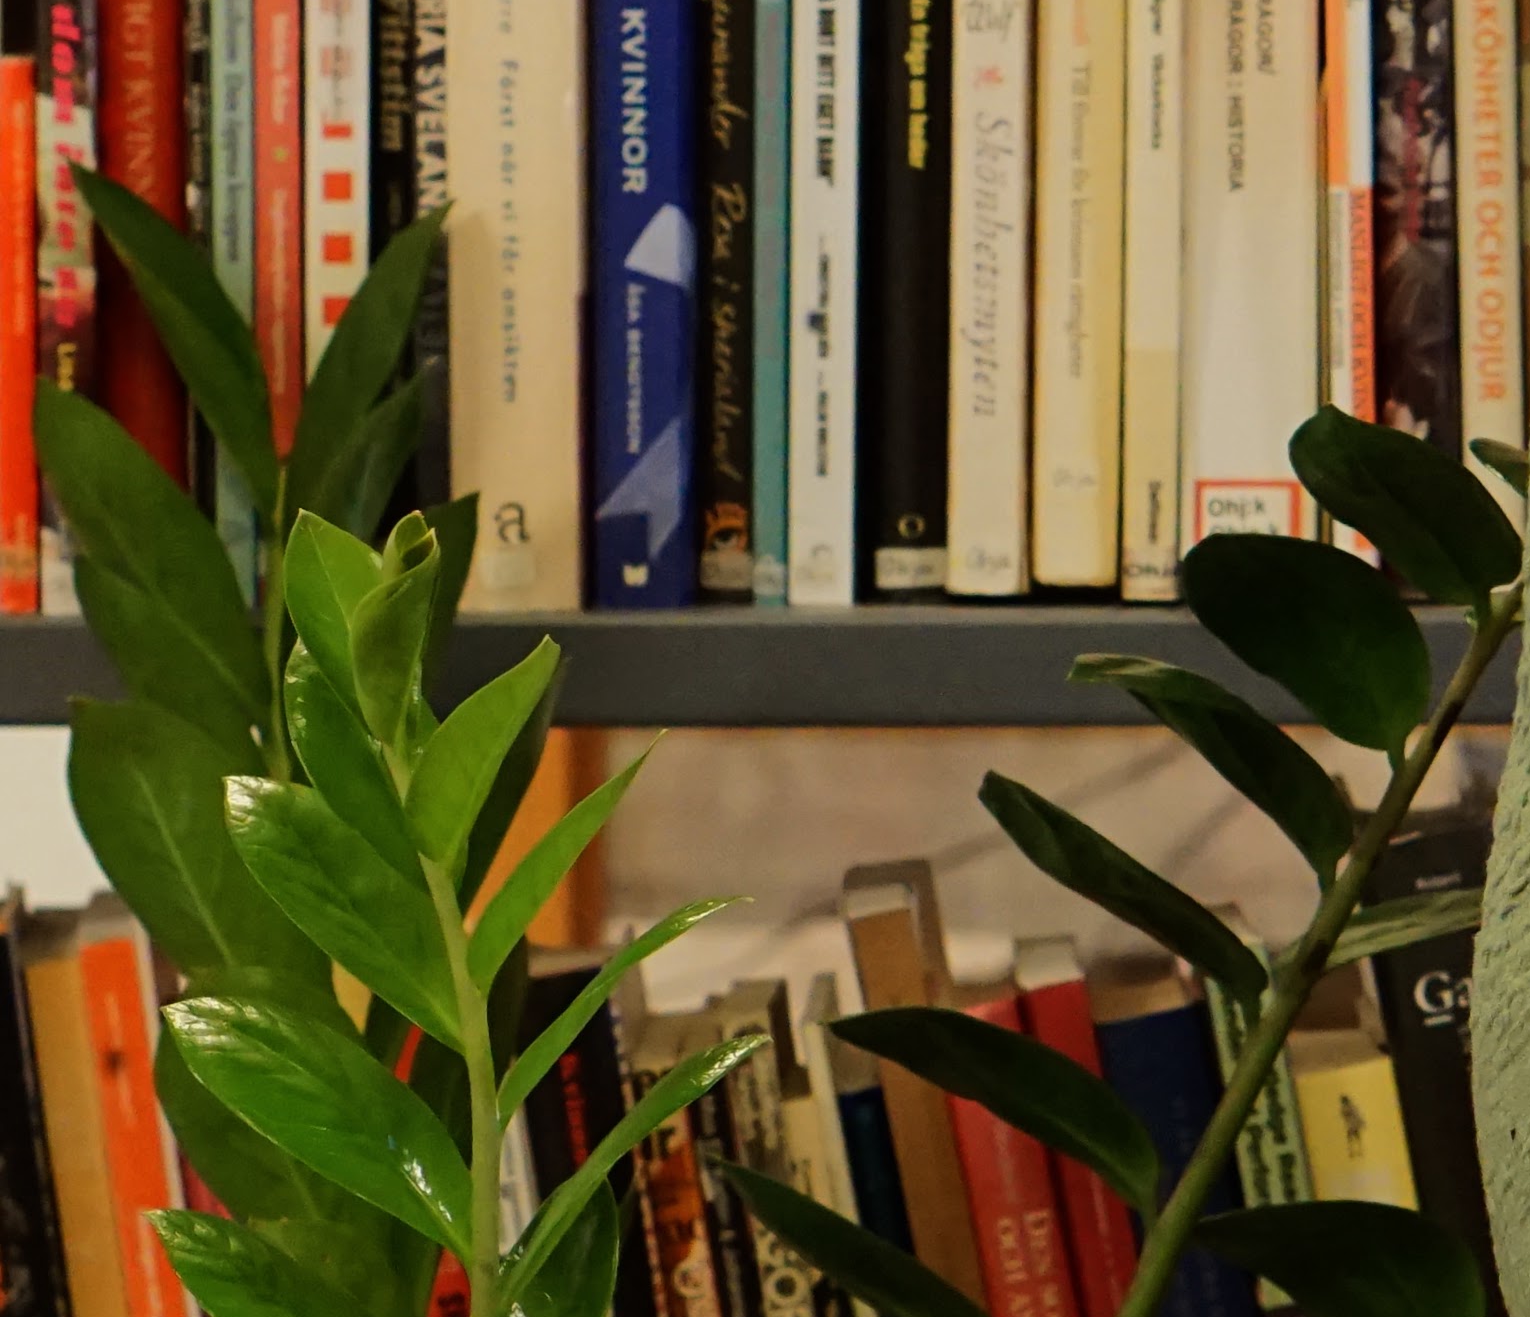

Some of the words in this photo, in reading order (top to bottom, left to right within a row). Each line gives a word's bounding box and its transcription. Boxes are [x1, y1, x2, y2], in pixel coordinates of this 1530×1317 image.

[414, 64, 446, 217] SVELAN
[619, 7, 647, 194] KVINNOR
[1225, 94, 1245, 193] HISTORIA
[498, 198, 518, 222] vi
[957, 111, 1016, 420] Skönhetsmyten
[1472, 198, 1507, 279] OCH
[498, 286, 522, 404] ansikten
[1350, 301, 1368, 350] OCH
[1469, 287, 1510, 404] ODJUR
